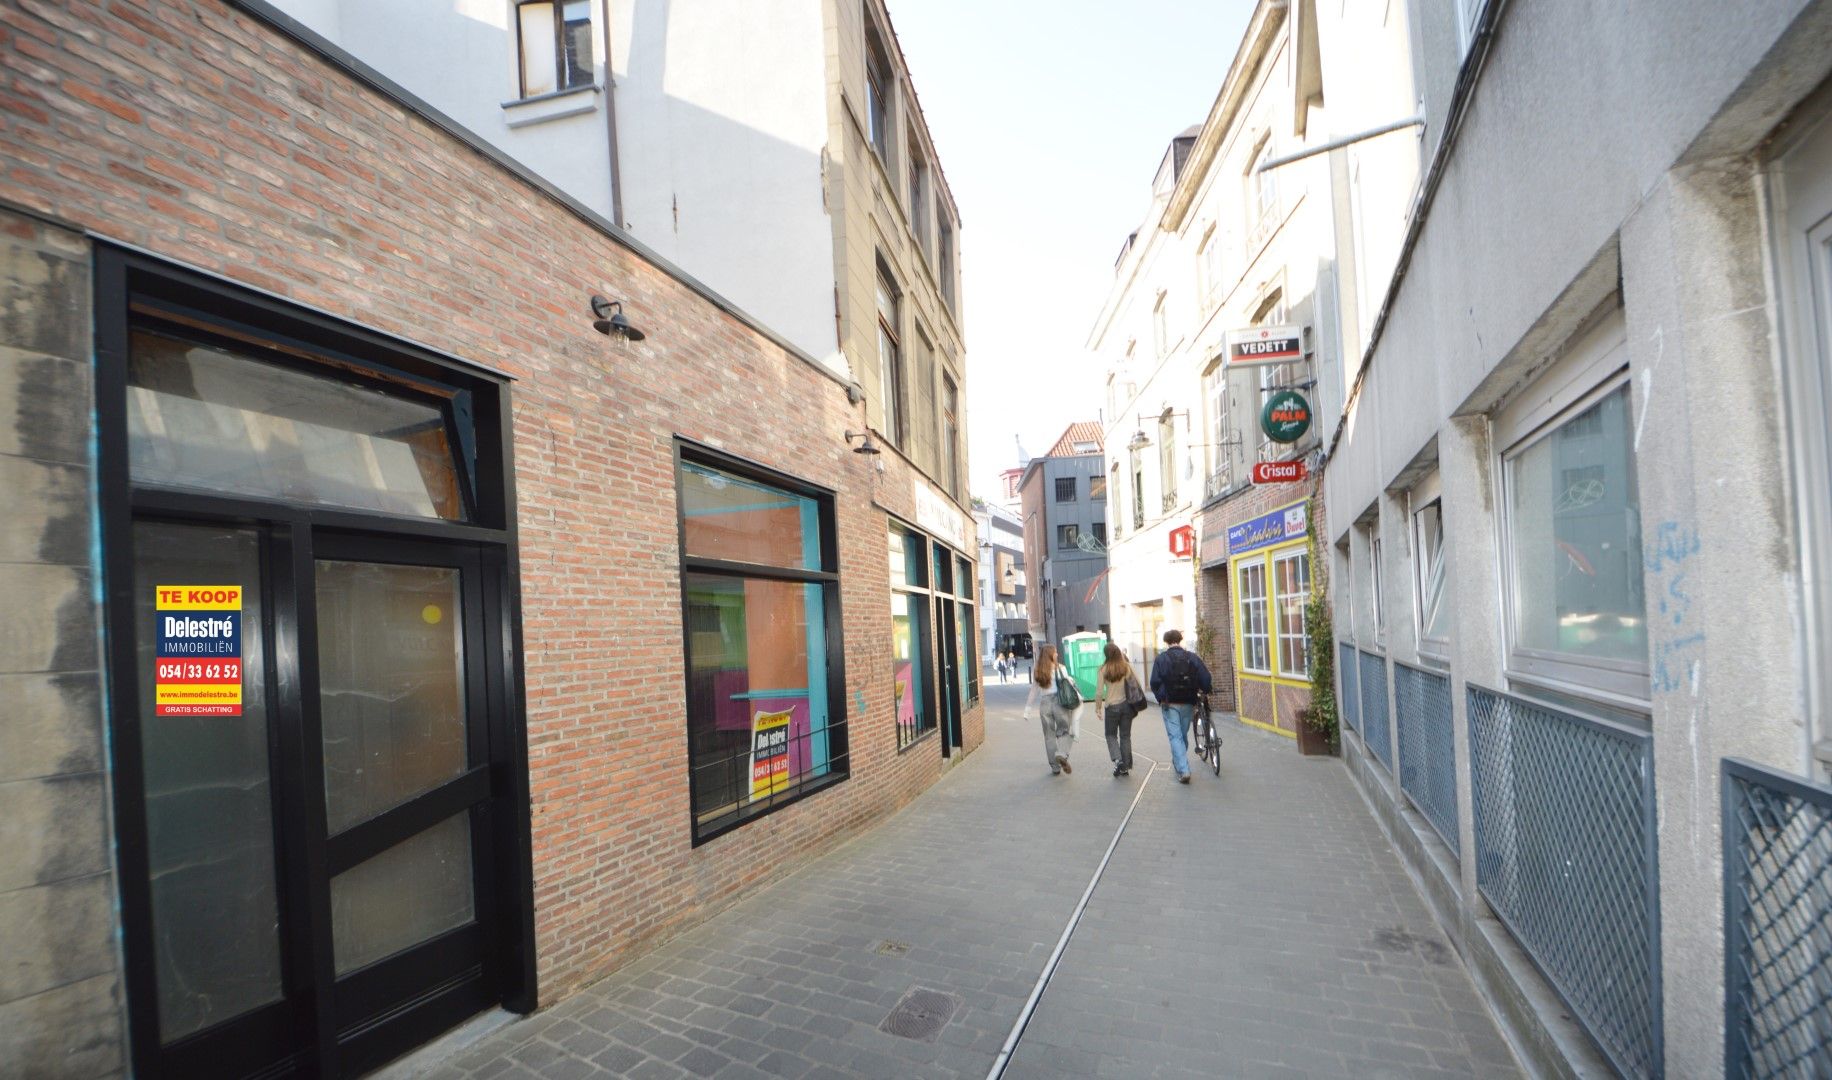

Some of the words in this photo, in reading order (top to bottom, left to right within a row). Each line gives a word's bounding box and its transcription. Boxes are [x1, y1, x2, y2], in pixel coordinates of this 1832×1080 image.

[1241, 340, 1288, 355] VEDETT
[1271, 409, 1306, 423] PALM
[1260, 464, 1297, 479] Cristal
[160, 591, 182, 603] TE
[188, 591, 238, 603] KOOP
[165, 615, 233, 638] Delestré
[165, 641, 233, 653] IMMOBILIËN
[160, 662, 202, 679] 054/33
[205, 664, 220, 678] 62
[223, 664, 238, 678] 52
[160, 690, 238, 698] www.immodelestre.be
